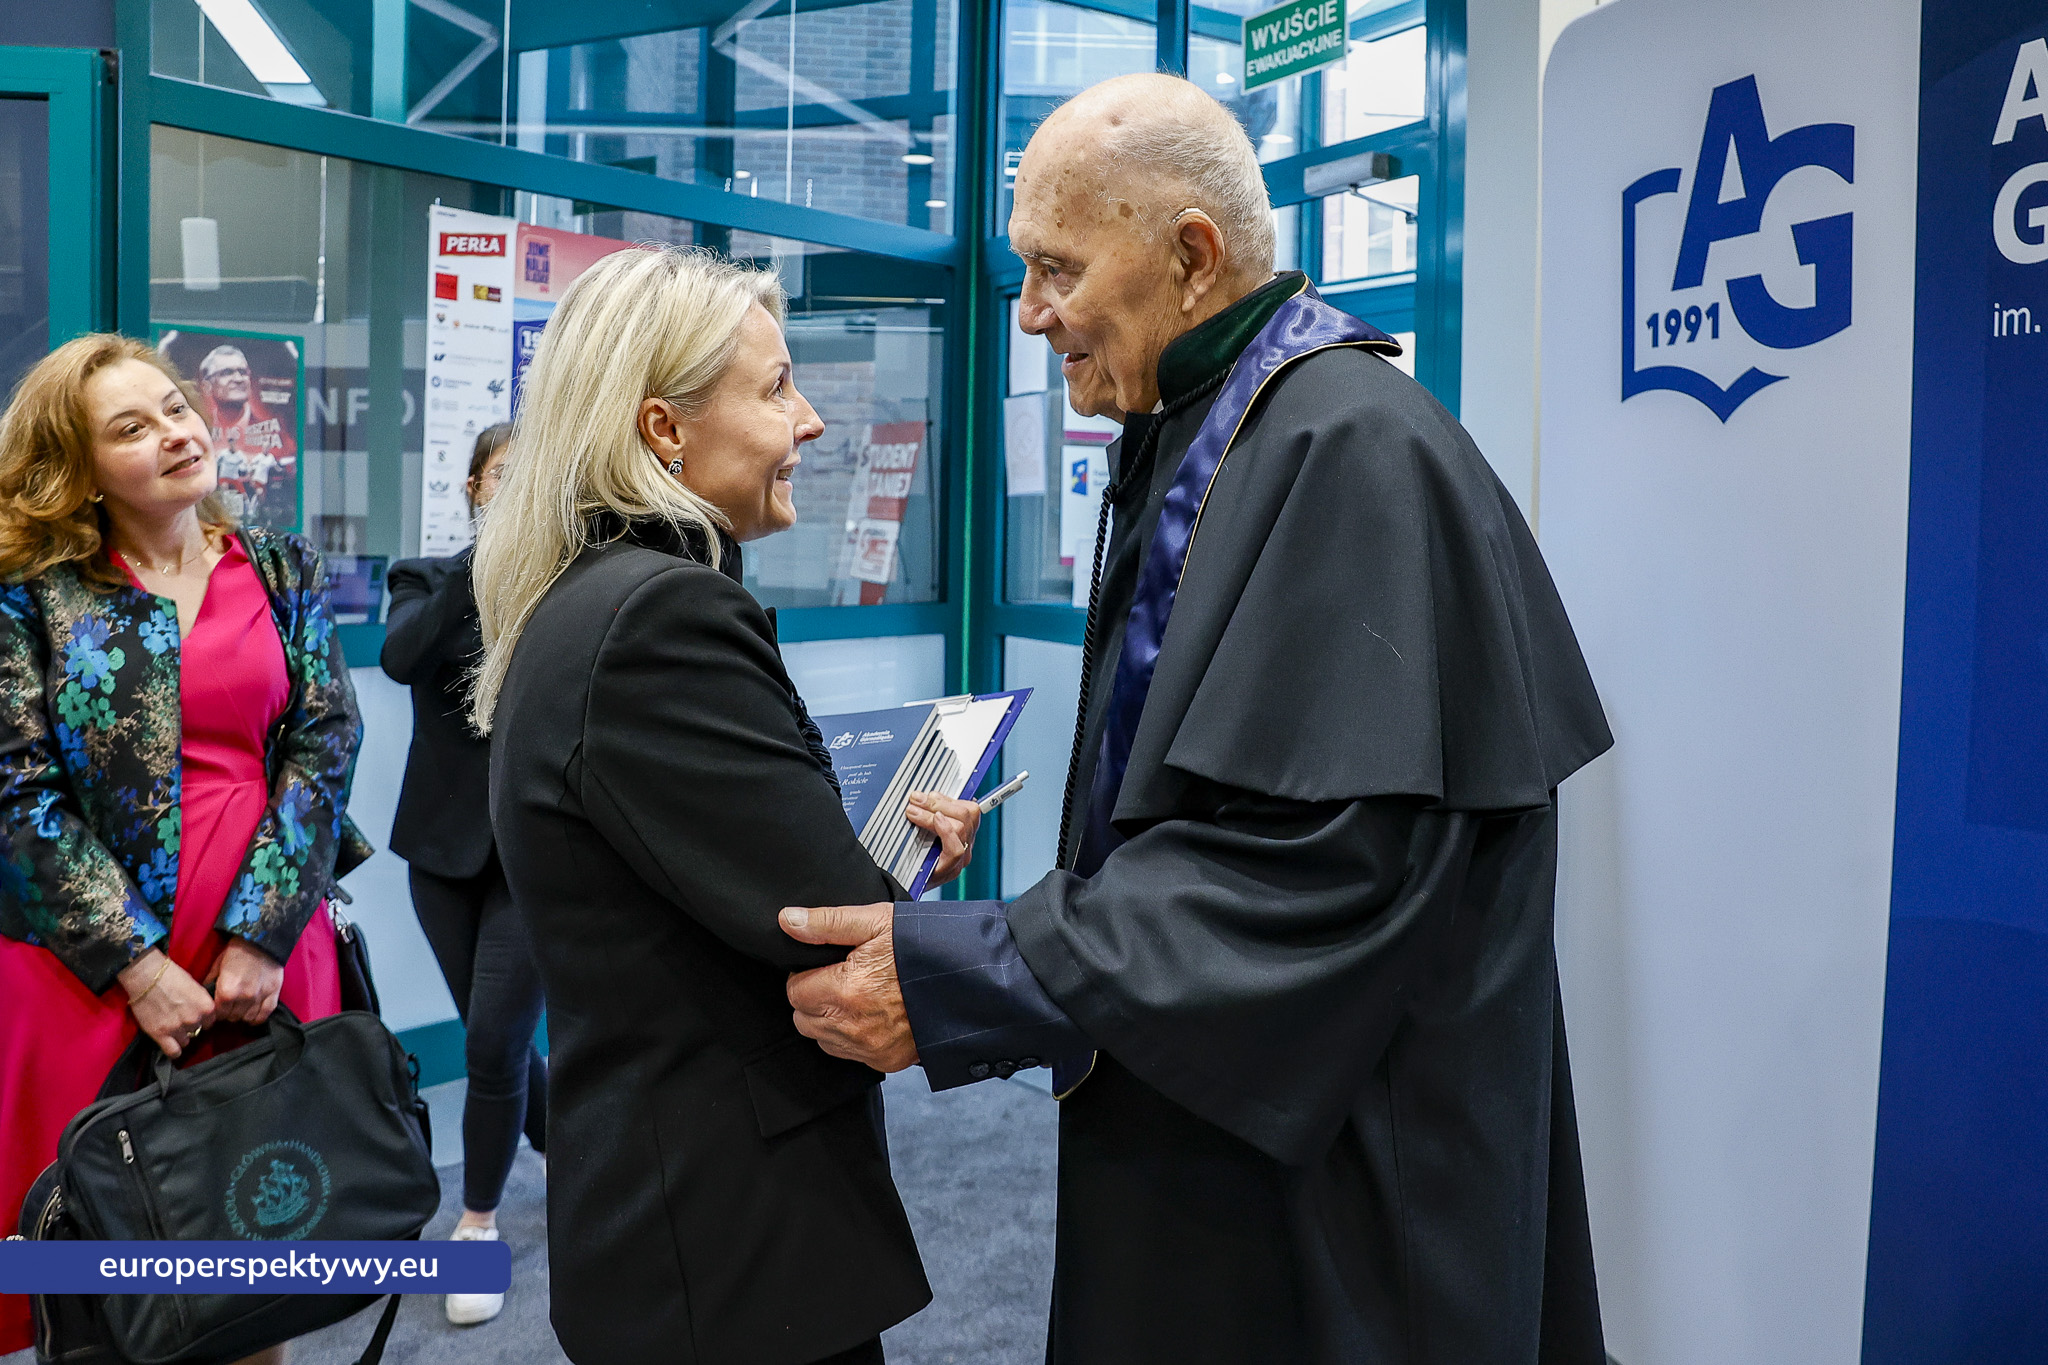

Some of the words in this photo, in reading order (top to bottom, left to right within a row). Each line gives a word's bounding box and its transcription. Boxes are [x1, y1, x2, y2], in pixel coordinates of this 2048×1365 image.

[1251, 0, 1338, 51] WYJŚCIE
[1246, 28, 1342, 77] EWAKUACYJNE
[446, 236, 500, 252] PERŁA
[1646, 302, 1719, 348] 1991
[1993, 303, 2041, 337] im.
[861, 443, 918, 469] STUDENT
